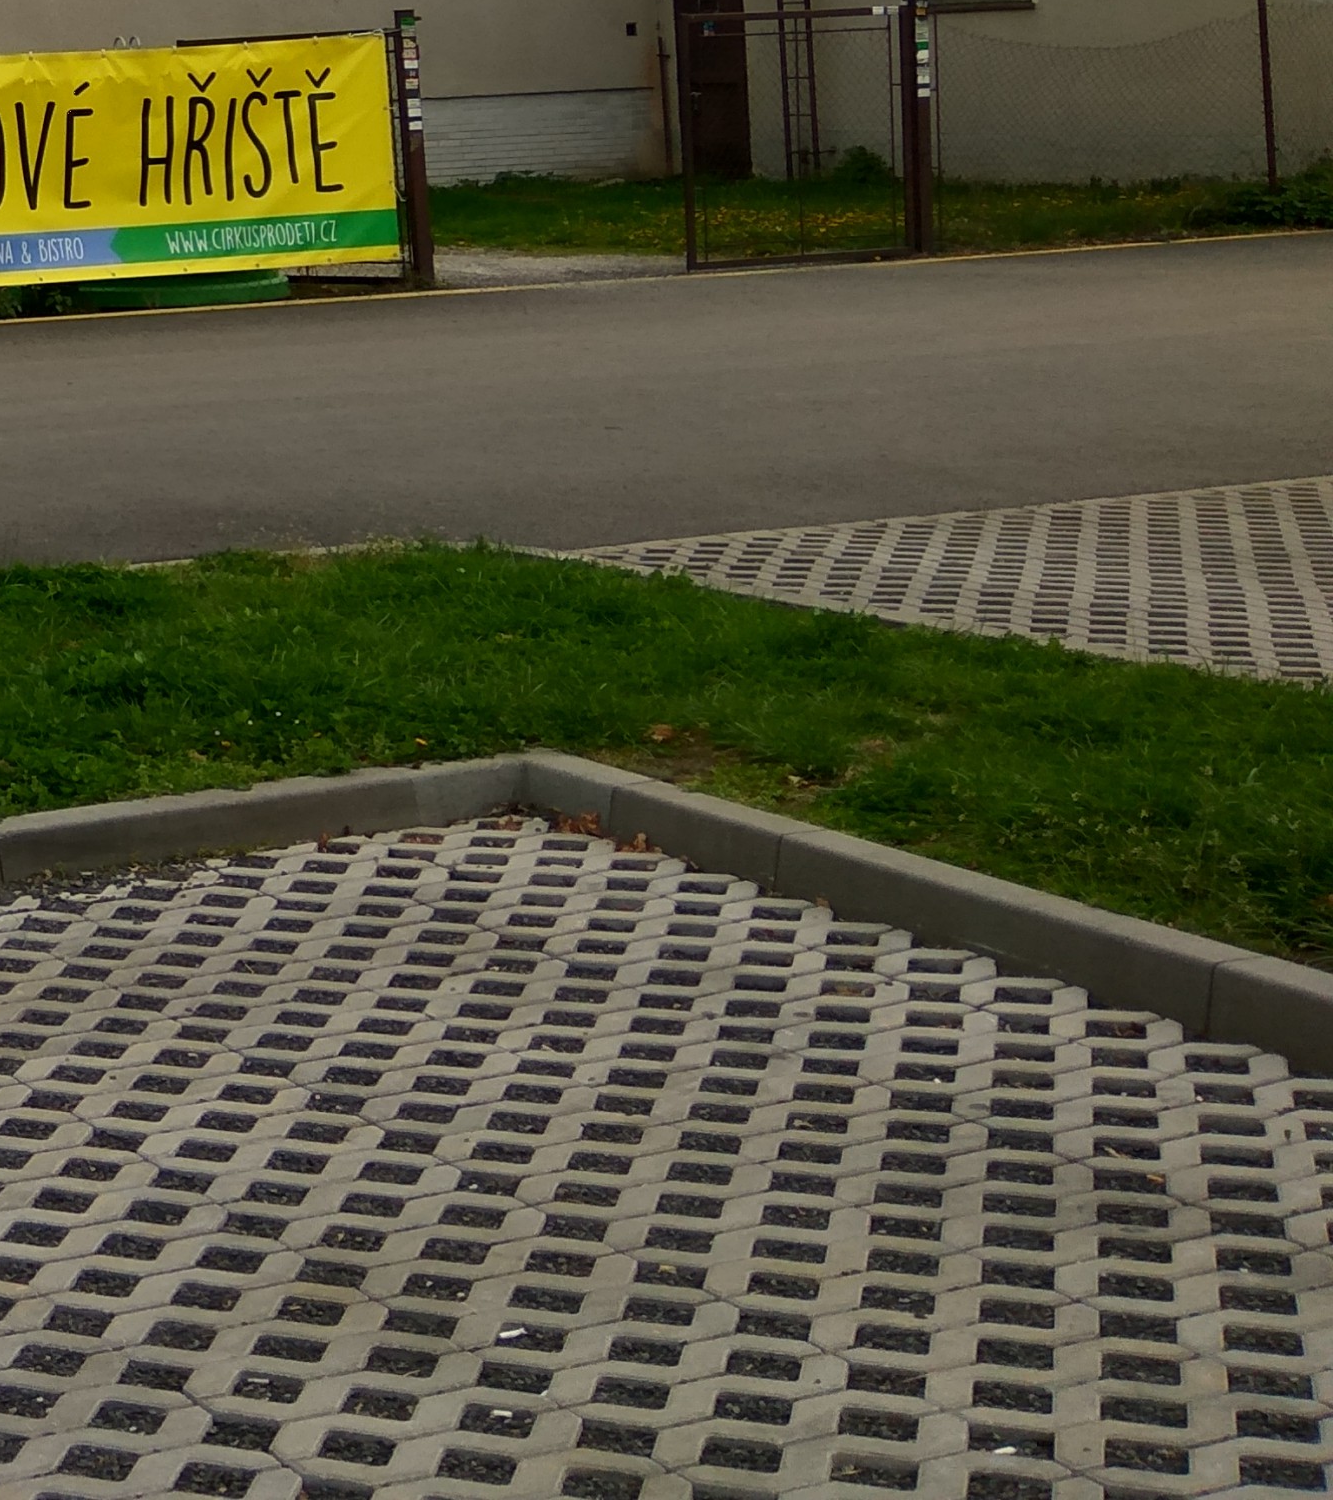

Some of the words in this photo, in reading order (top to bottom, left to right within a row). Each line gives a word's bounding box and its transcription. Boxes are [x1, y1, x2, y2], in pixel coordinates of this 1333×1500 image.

[139, 66, 344, 207] HŘIŠTĚ
[21, 242, 32, 265] &
[38, 237, 84, 263] BISTRO
[165, 220, 338, 254] WWW.CIRKUSPRODETI.CZ
